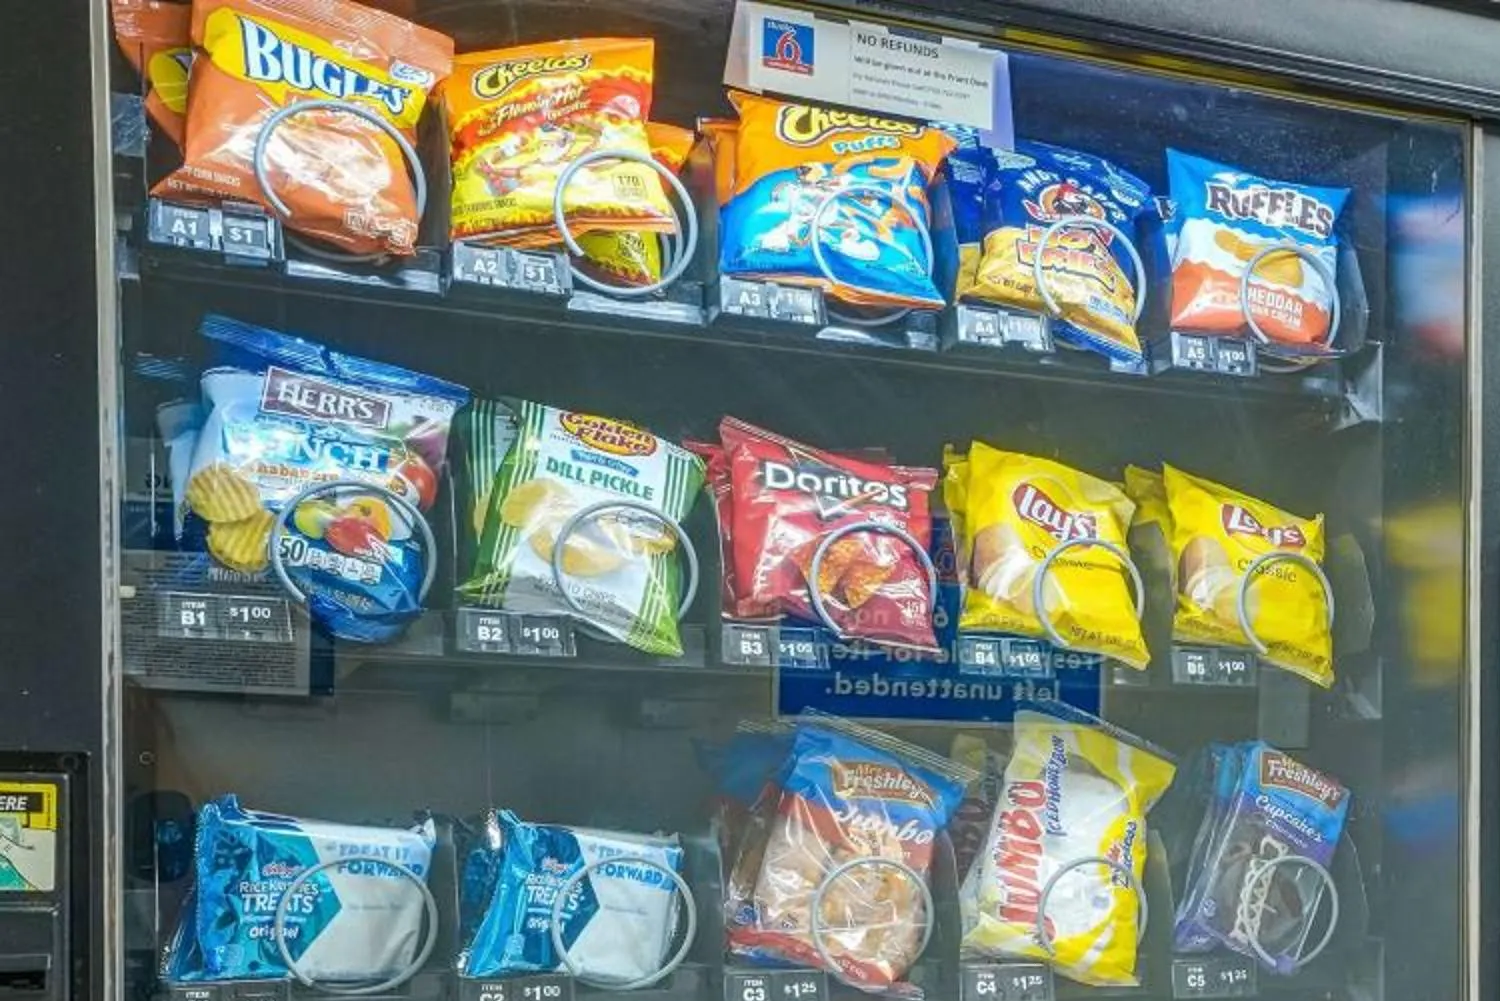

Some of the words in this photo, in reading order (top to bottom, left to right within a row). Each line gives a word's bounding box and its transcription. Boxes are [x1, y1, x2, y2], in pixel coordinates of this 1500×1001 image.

[856, 33, 877, 47] NO
[880, 38, 940, 60] REFUNDS
[239, 15, 411, 114] BUGLES
[475, 54, 592, 98] Cheetos
[1206, 183, 1334, 237] RUFFLES
[171, 219, 198, 236] A1
[473, 260, 498, 274] A2
[738, 291, 761, 305] A3
[279, 380, 378, 421] HERR'S
[546, 457, 587, 484] DILL
[589, 470, 655, 499] PICKLE
[764, 461, 908, 507] Doritos
[1019, 485, 1098, 540] Lay's
[180, 610, 205, 626] B1
[477, 627, 503, 641] B2
[740, 640, 763, 655] B3
[836, 810, 934, 846] Jumbo
[1255, 795, 1325, 844] Cupcakes
[596, 863, 662, 885] FORWARD
[742, 985, 766, 1001] C3
[975, 980, 997, 995] C4
[1186, 974, 1206, 988] C5
